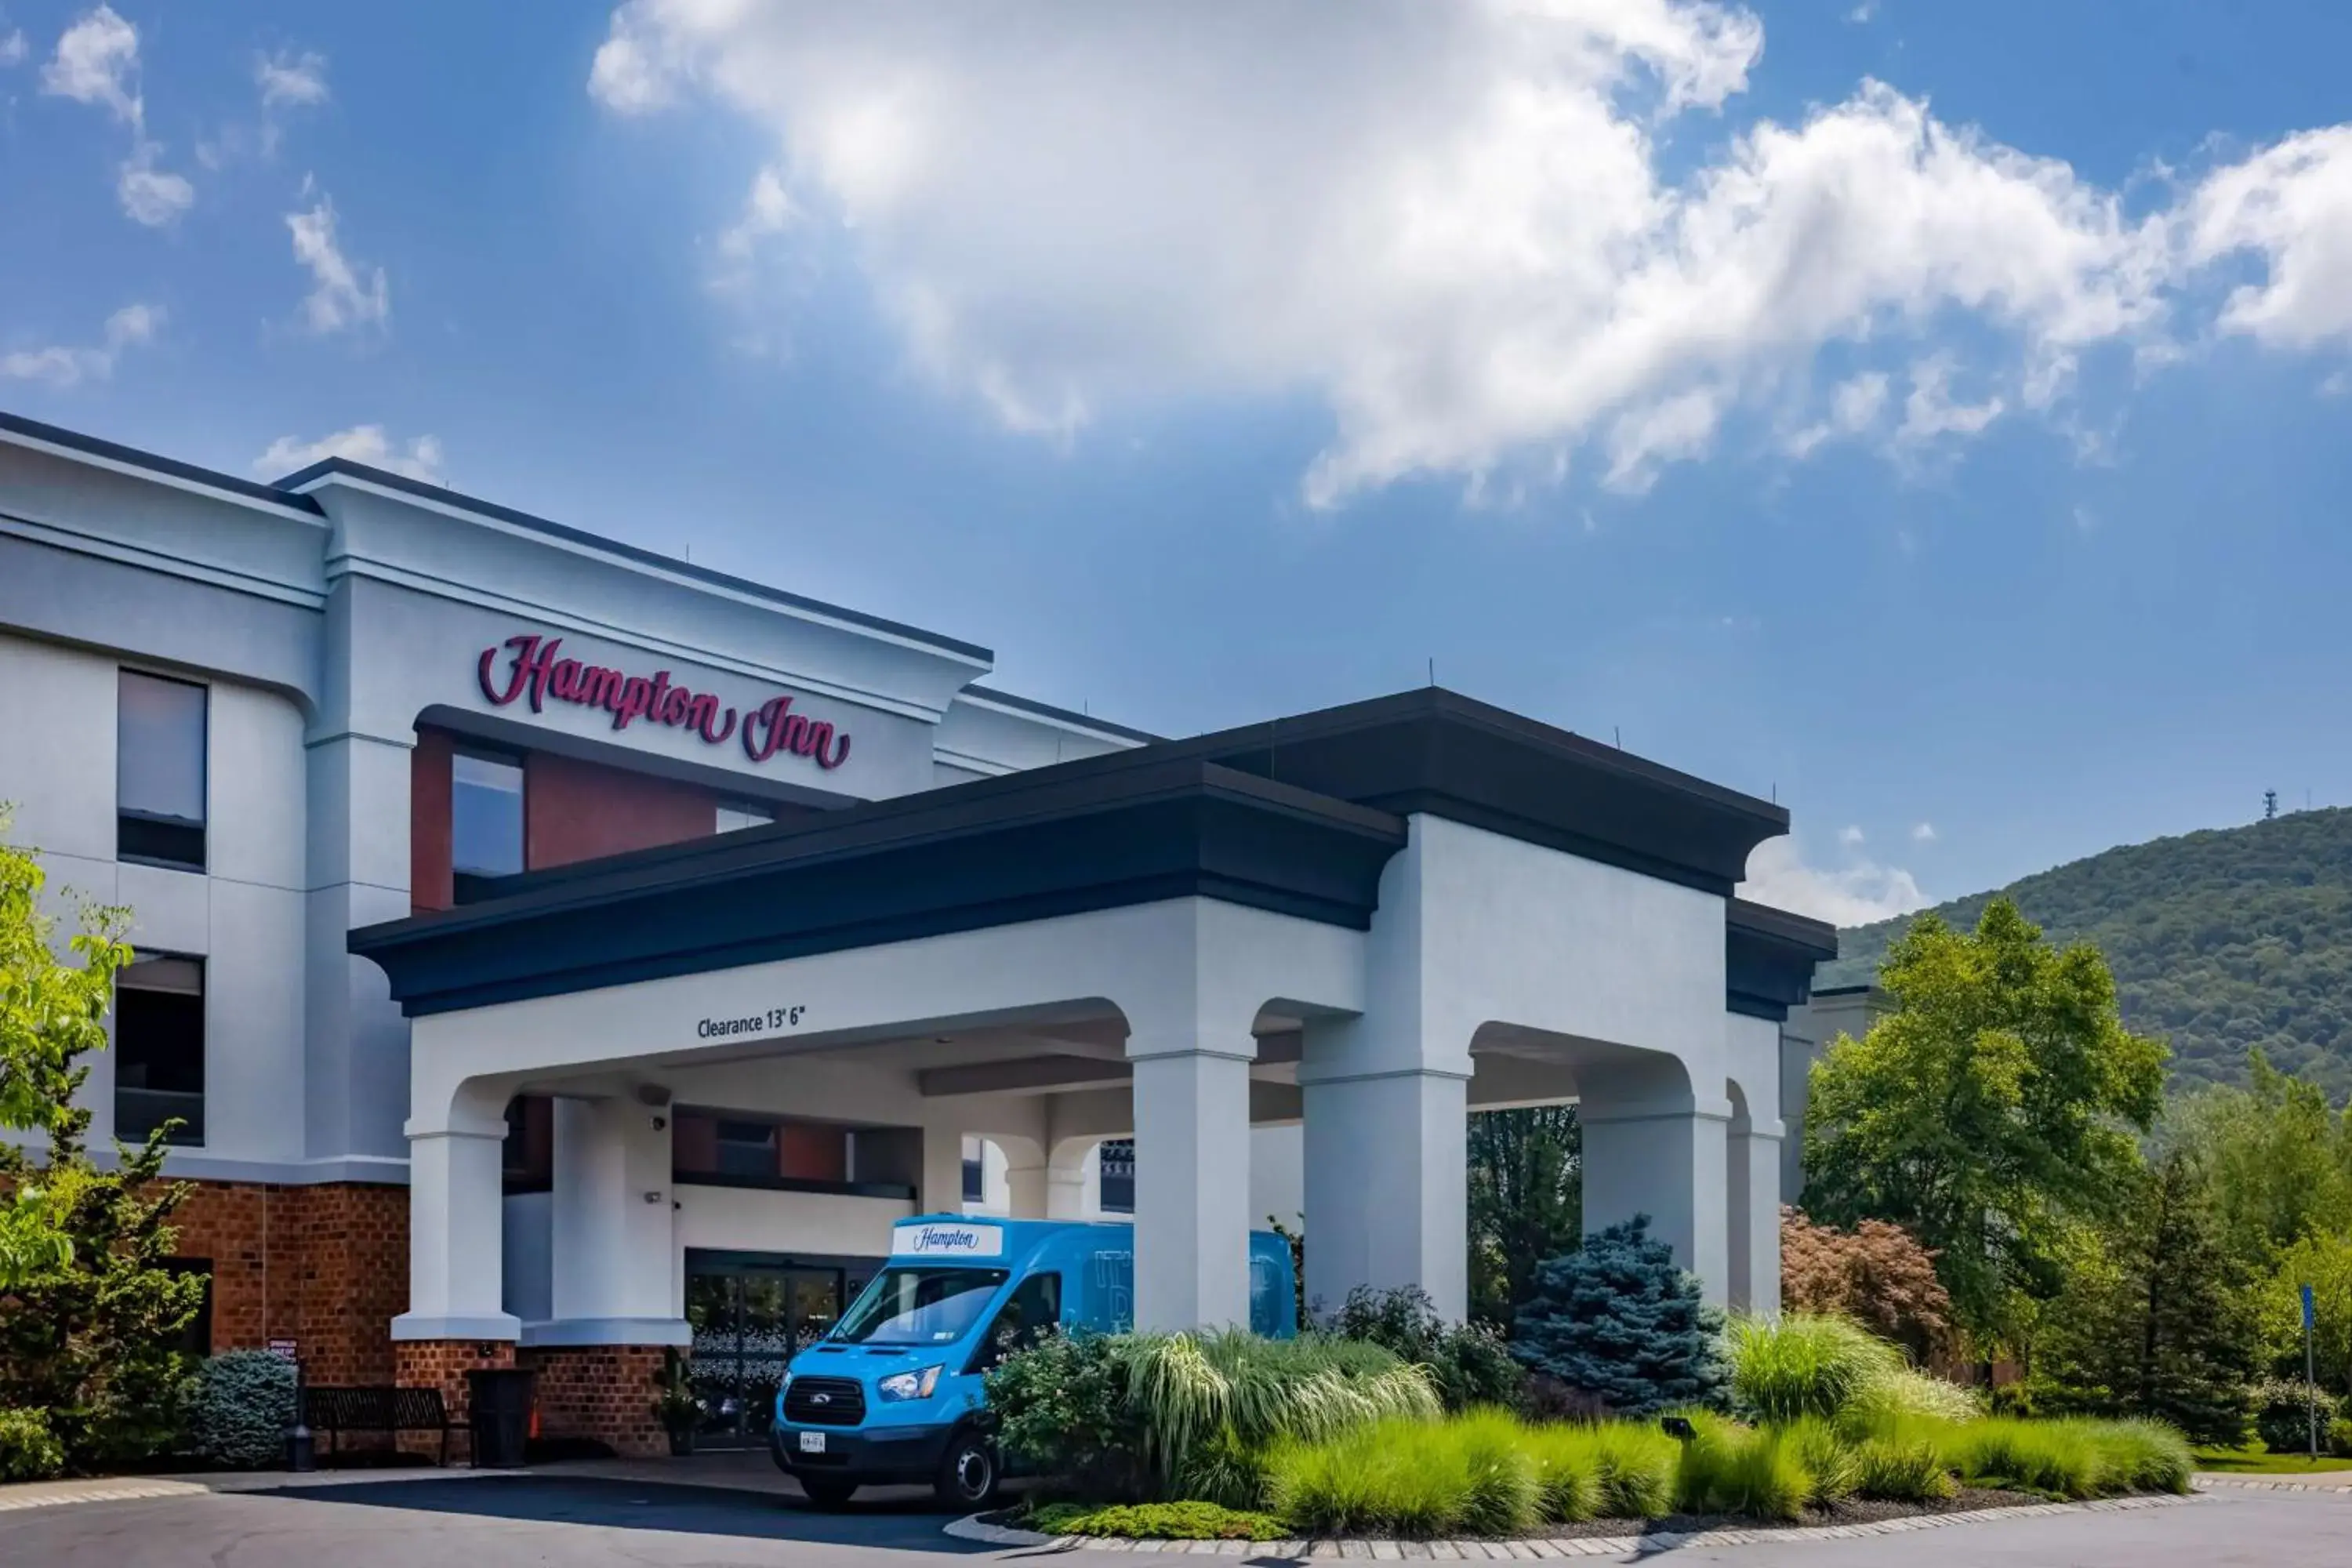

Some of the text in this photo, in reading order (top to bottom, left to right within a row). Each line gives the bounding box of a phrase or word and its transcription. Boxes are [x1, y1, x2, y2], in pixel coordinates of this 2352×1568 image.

[477, 633, 851, 770] Hampton Inn
[698, 1016, 763, 1038] Clearance
[913, 1226, 979, 1252] Hampton
